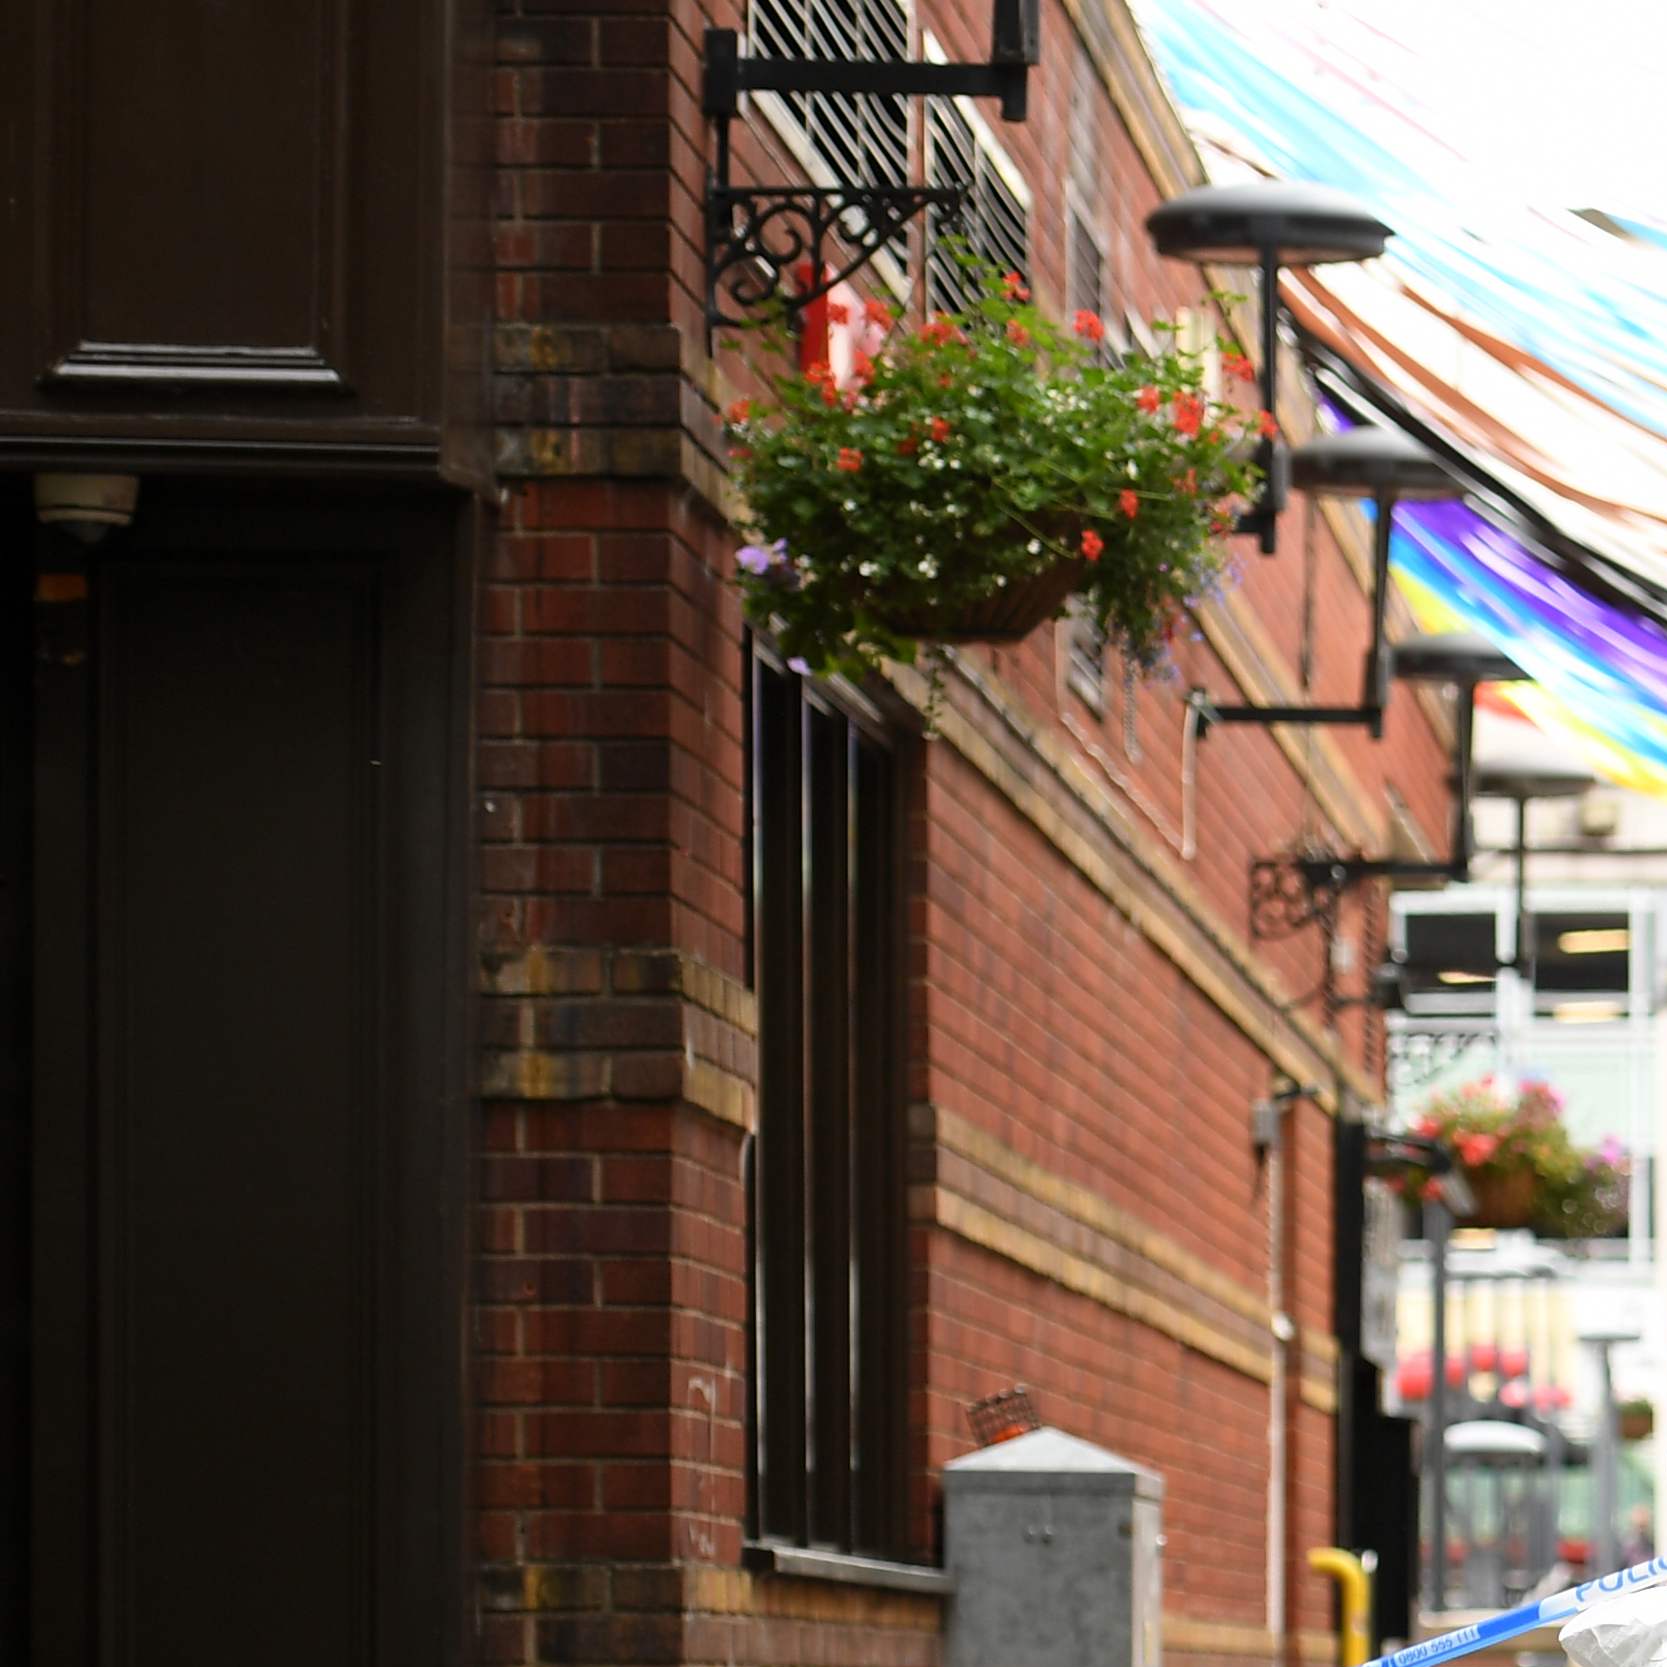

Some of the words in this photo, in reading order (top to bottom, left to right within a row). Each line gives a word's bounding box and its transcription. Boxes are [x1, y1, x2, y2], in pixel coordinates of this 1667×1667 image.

[1398, 1646, 1428, 1665] 0800
[1430, 1639, 1453, 1653] 555
[1456, 1627, 1477, 1644] 111
